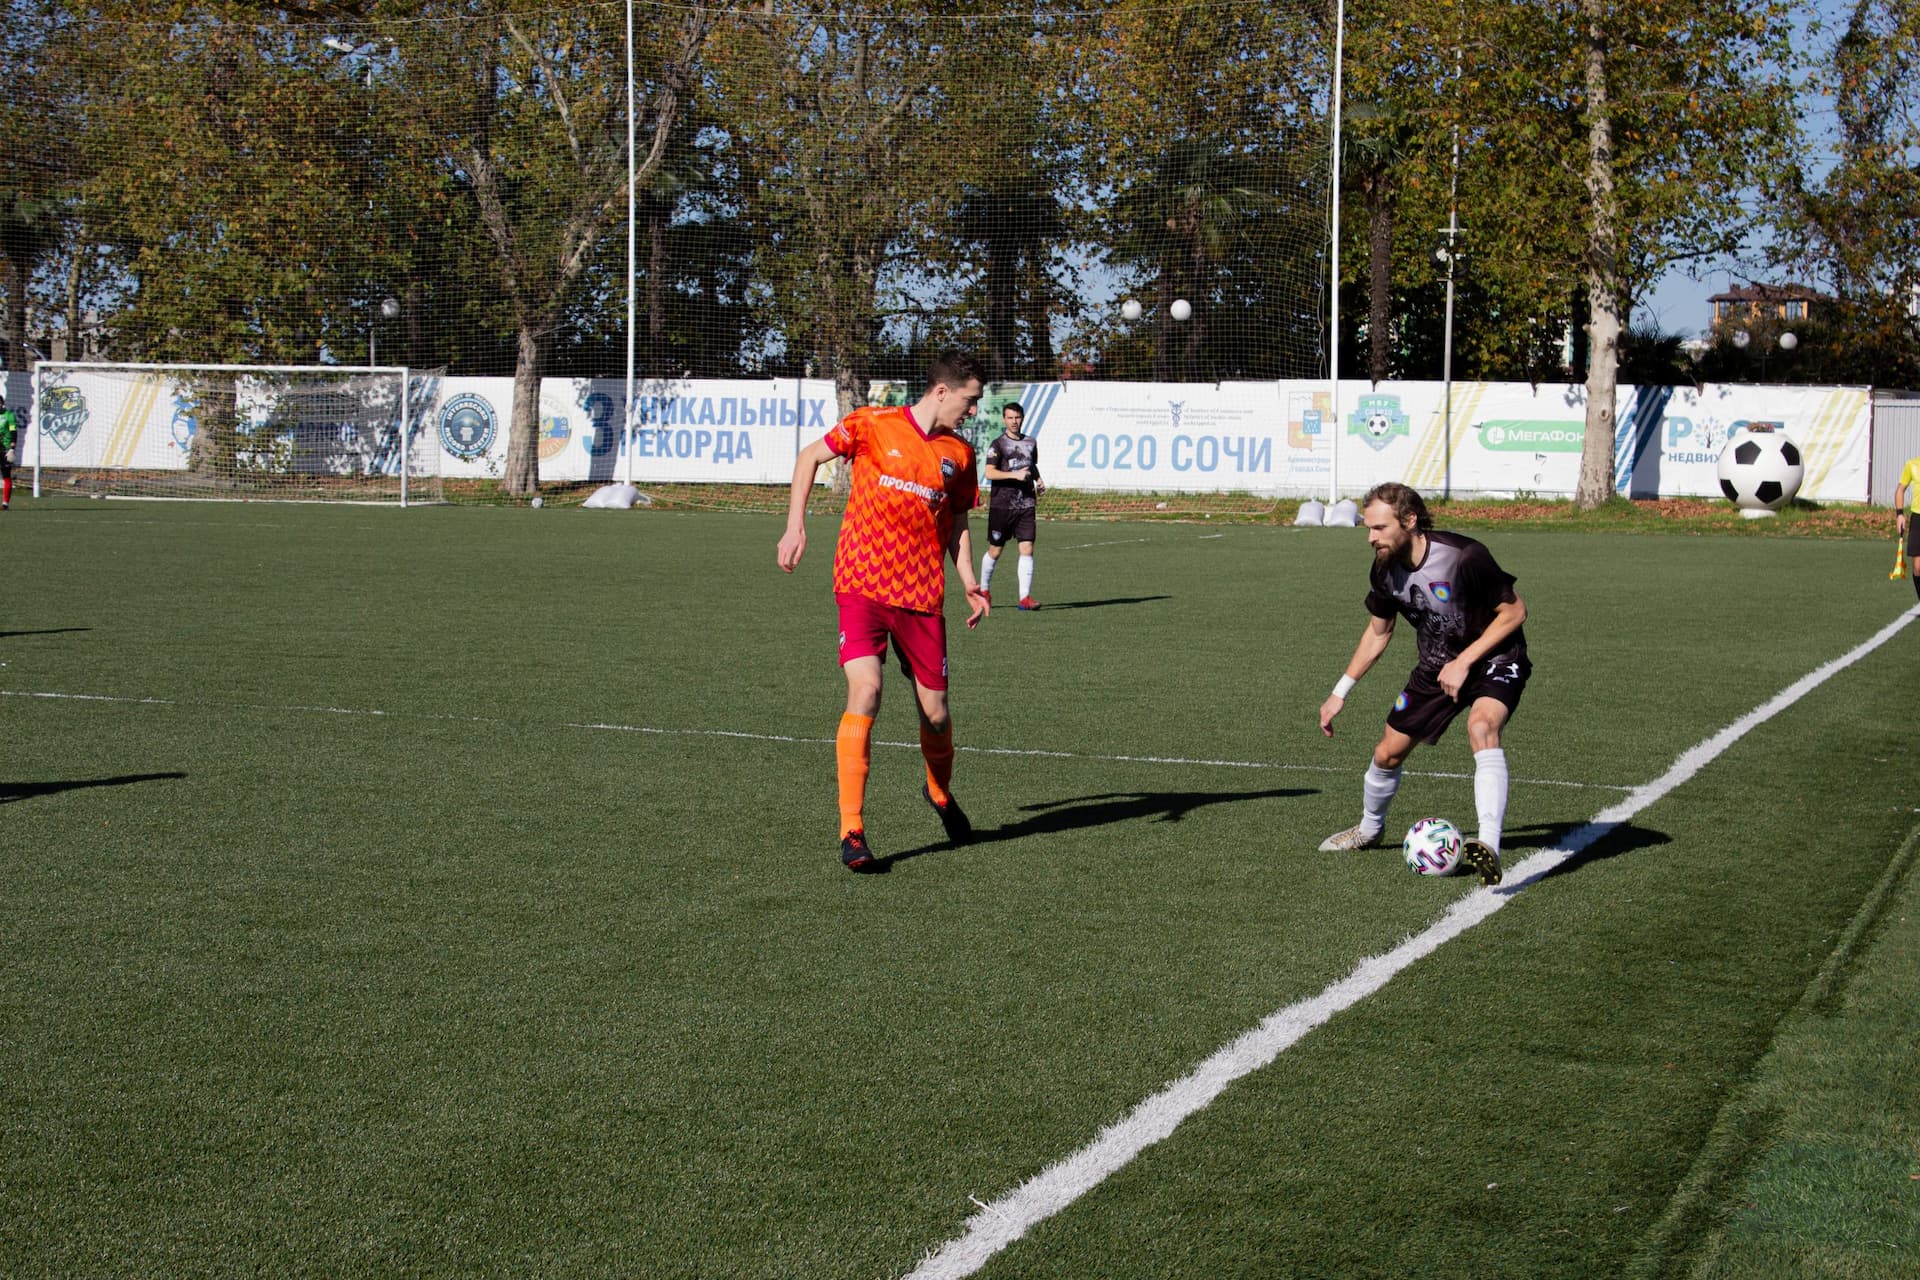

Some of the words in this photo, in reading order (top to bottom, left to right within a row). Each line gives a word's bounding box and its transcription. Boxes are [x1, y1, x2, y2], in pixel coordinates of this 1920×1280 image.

[446, 402, 488, 421] INTERRECORD
[625, 396, 826, 427] УНИКАЛЬНЫХ
[445, 427, 465, 450] RECORD
[469, 428, 489, 450] KEEPER
[620, 430, 752, 464] РЕКОРДА
[1067, 433, 1157, 471] 2020
[1171, 435, 1272, 473] СОЧИ
